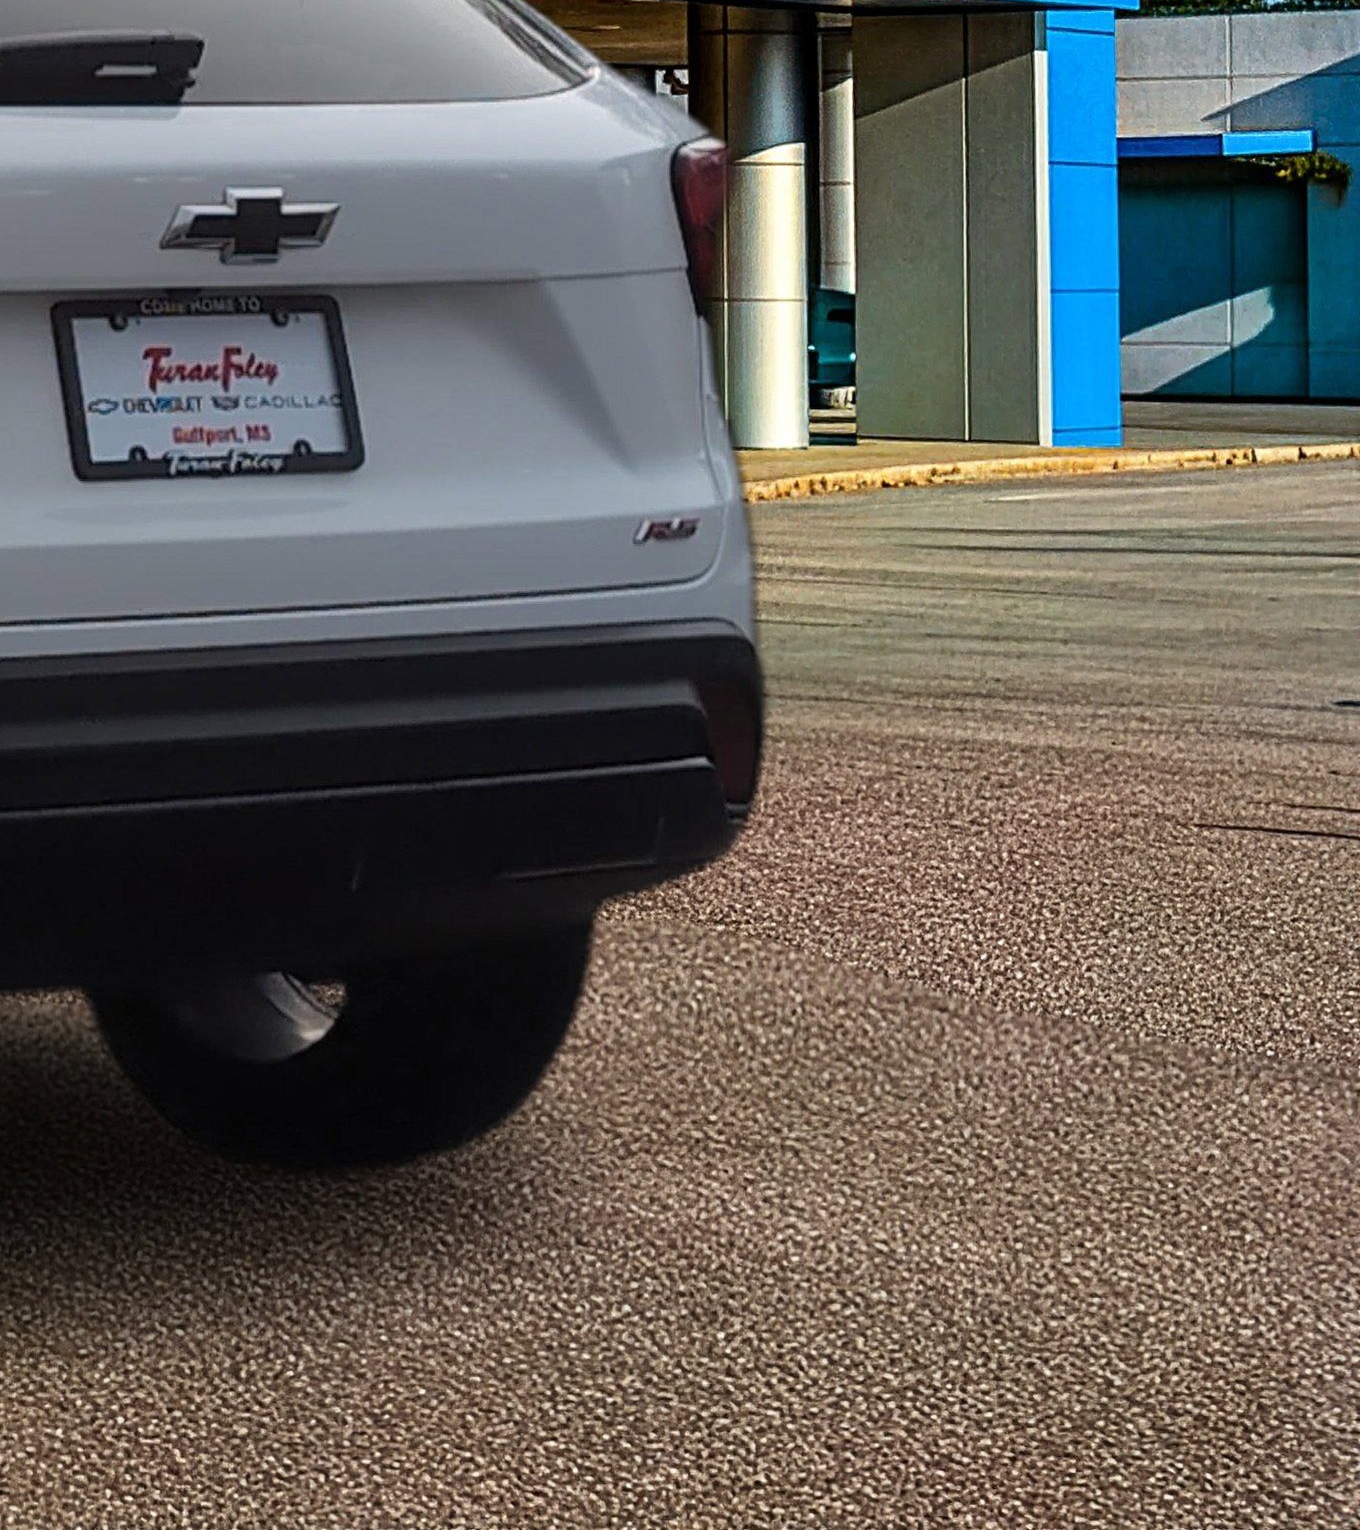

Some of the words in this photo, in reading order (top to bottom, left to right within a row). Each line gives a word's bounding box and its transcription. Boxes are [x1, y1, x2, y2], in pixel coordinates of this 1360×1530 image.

[239, 294, 261, 312] TO
[123, 396, 202, 414] CHEVROLET
[245, 395, 344, 410] CADILLAC
